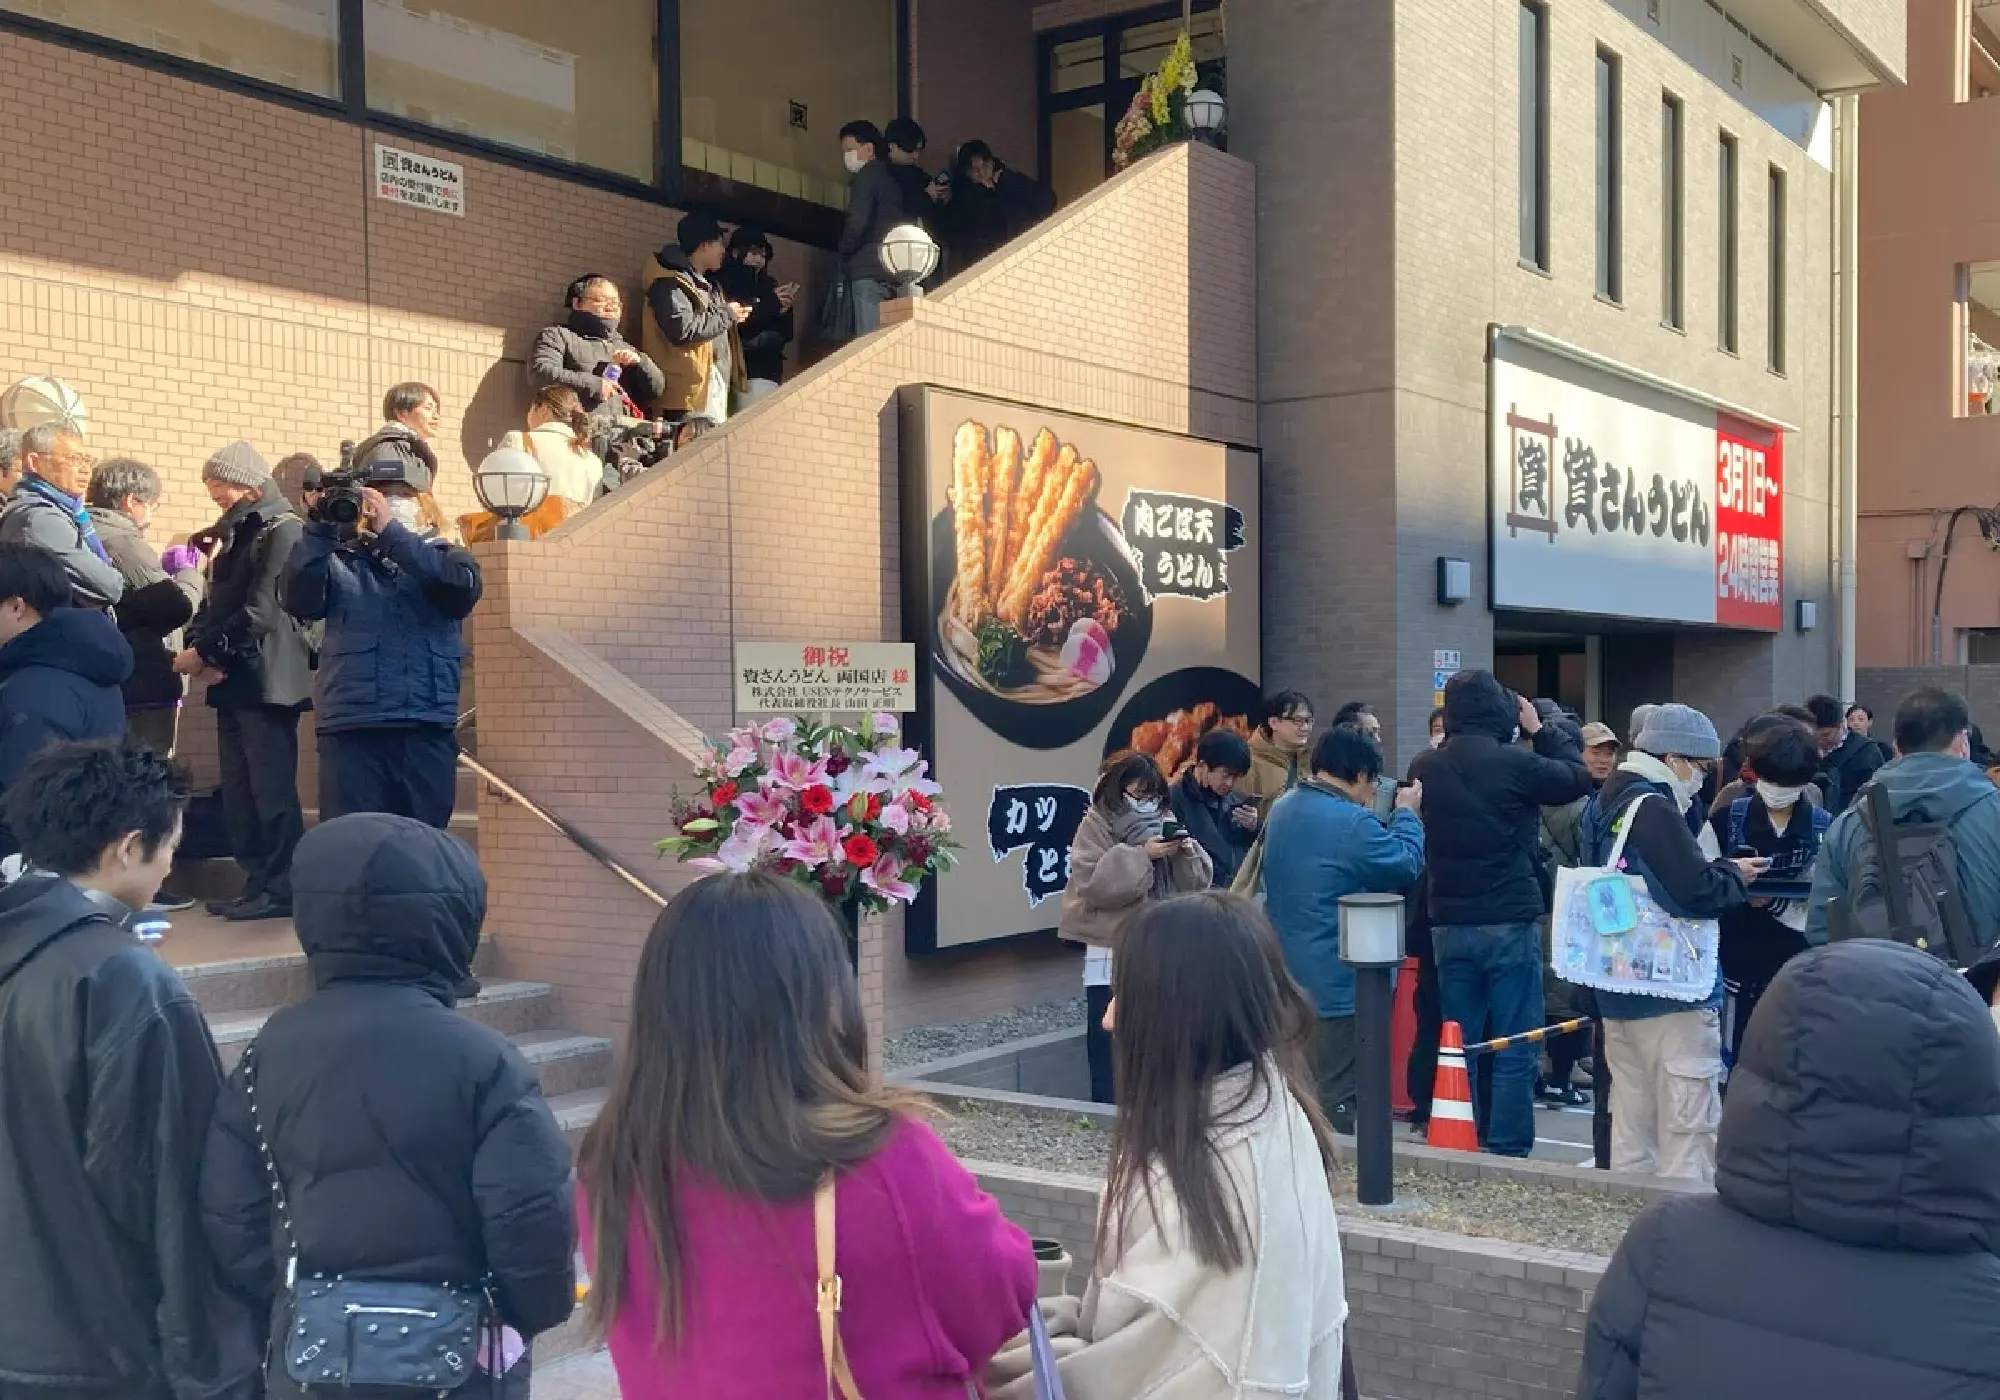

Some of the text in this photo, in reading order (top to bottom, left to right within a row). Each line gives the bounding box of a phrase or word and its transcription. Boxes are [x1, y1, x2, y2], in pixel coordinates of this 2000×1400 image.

[1563, 436, 1710, 547] 資さんうどん
[1134, 499, 1214, 545] 肉ごぼ天
[1157, 551, 1214, 589] うどん
[1719, 532, 1779, 606] 24時間営業
[802, 645, 850, 667] 御祝
[743, 668, 908, 684] 資さんうどん 両国店 様
[752, 686, 903, 698] 株式会社 USENテクノサービス
[759, 698, 841, 709] 代表取締役社長
[1006, 797, 1058, 834] カツ
